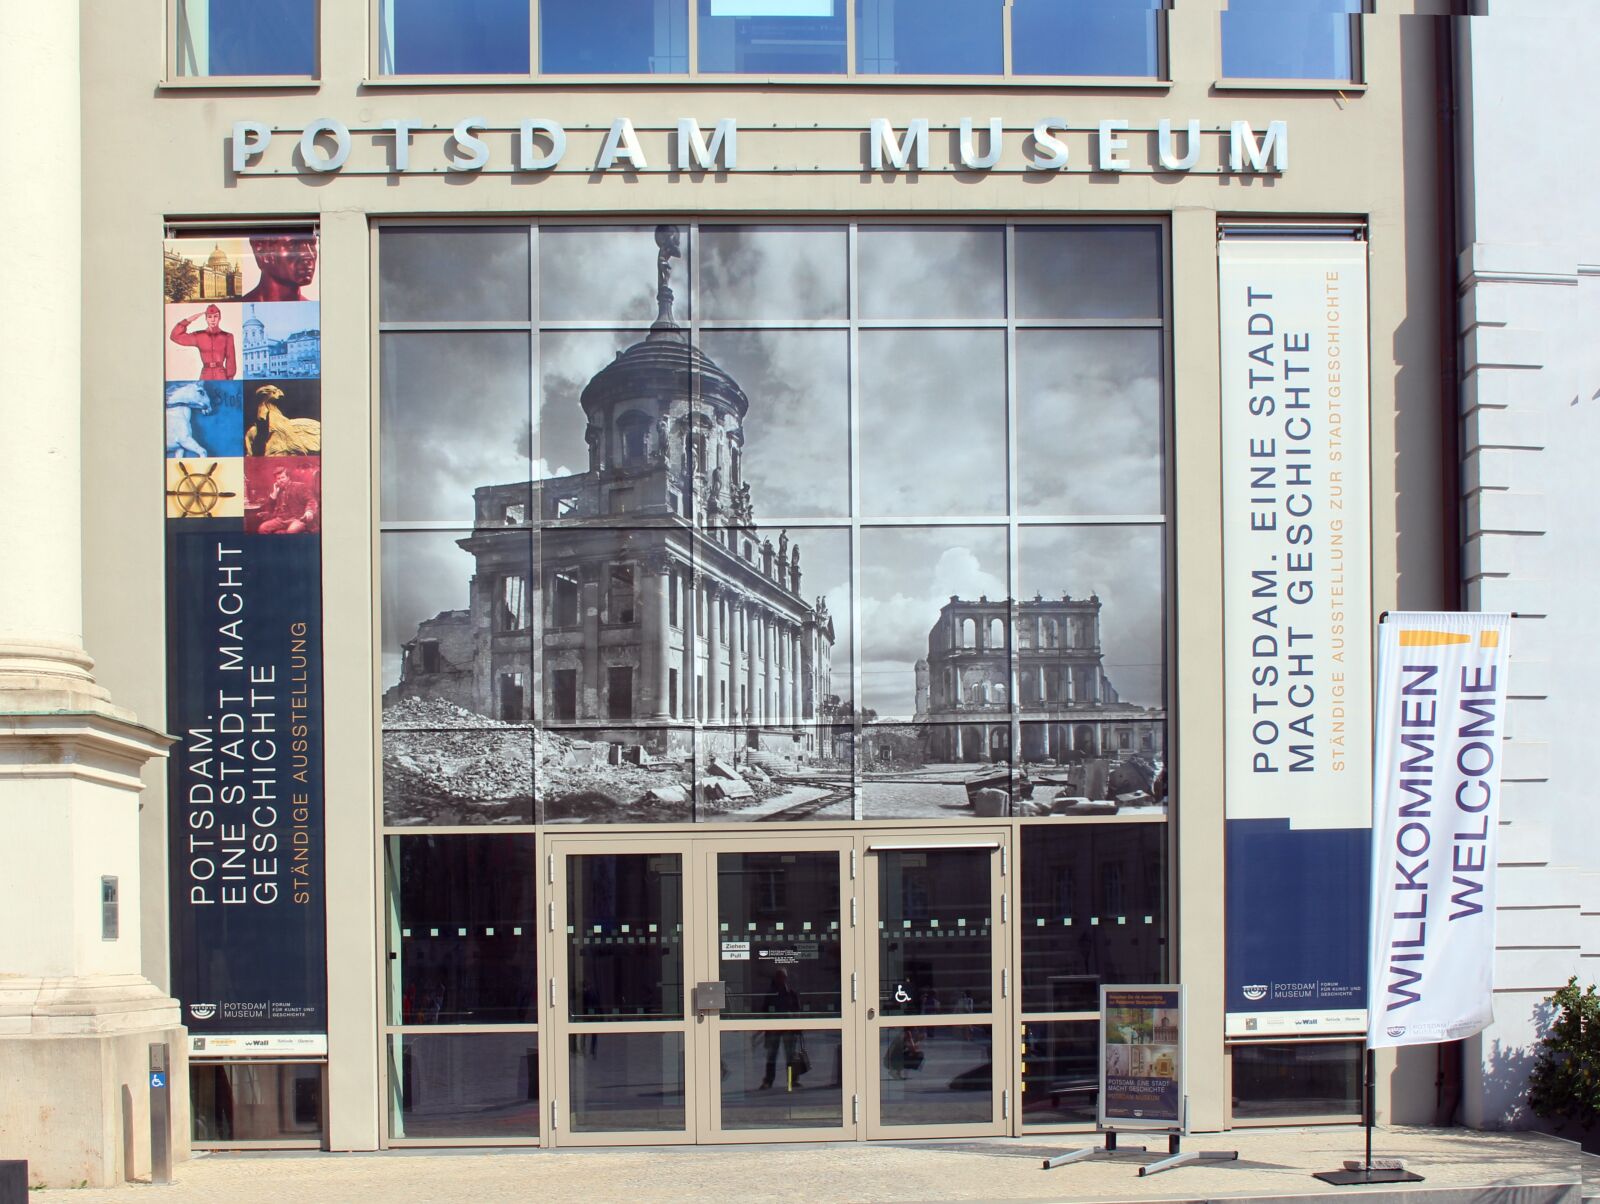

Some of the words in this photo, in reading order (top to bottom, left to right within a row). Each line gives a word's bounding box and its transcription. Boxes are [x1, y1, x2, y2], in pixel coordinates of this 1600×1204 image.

[232, 117, 738, 173] POTSDAM
[869, 117, 1289, 173] MUSEUM
[1247, 286, 1276, 417] STADT
[1326, 271, 1343, 462] STADTGESCHICHTE
[1249, 438, 1277, 531] EINE
[1283, 333, 1314, 605] GESCHICHTE
[1329, 471, 1343, 510] ZUR
[217, 542, 245, 671] MACHT
[1329, 519, 1345, 663] AUSSTELLUNG
[290, 621, 309, 783] AUSSTELLUNG
[1251, 555, 1279, 773] POTSDAM.
[1287, 626, 1315, 773] MACHT
[1329, 672, 1345, 772] STÄNDIGE
[188, 714, 215, 905] POTSDAM.
[219, 689, 246, 805] STADT
[250, 664, 279, 905] GESCHICHTE
[1448, 664, 1498, 921] WELCOME
[220, 823, 247, 905] EINE
[290, 792, 310, 905] STÄNDIGE
[1386, 665, 1439, 1012] WILLKOMMEN
[224, 1002, 267, 1010] POTSDAM
[224, 1010, 263, 1018] MUSEUM
[1274, 983, 1316, 991] POTSDAM
[1274, 990, 1312, 998] MUSEUM
